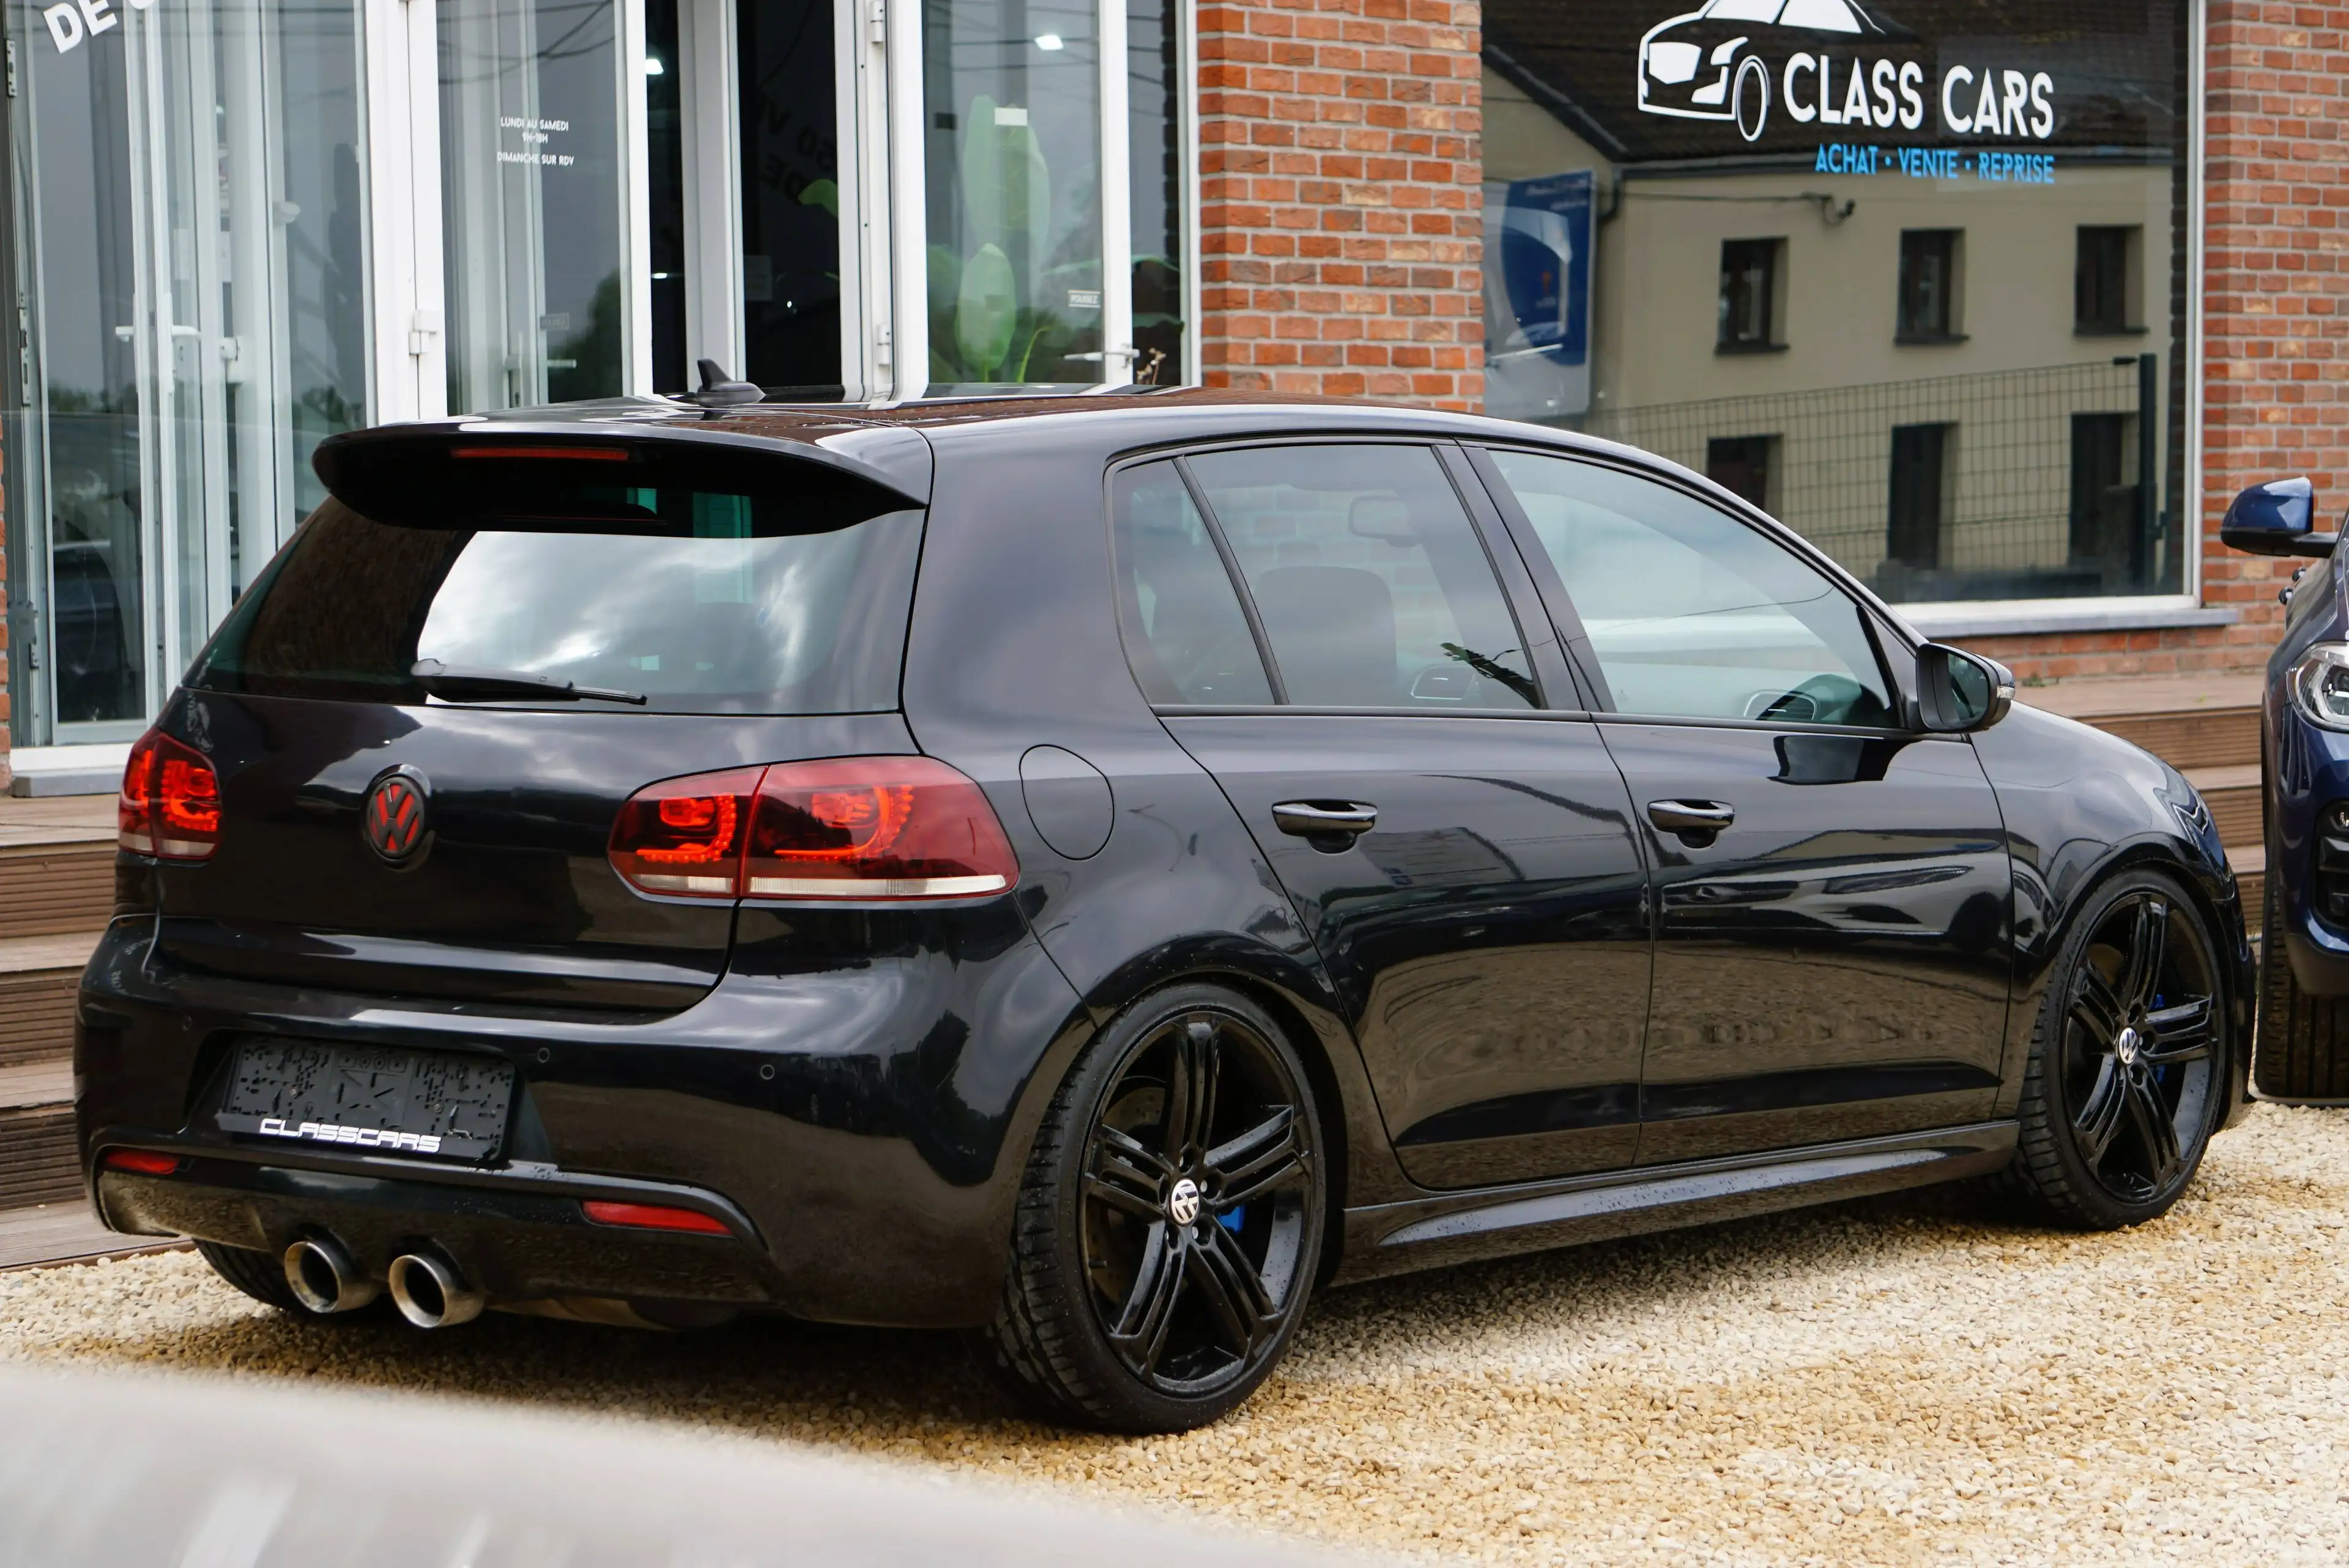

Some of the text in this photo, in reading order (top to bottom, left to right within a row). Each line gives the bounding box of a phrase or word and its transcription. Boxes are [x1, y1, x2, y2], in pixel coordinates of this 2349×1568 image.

[1783, 52, 2054, 139] CLASS CARS
[500, 116, 569, 131] LUNDI AU SAMEDI
[497, 151, 574, 166] DIMANCHE SUR RDV
[1815, 143, 2055, 183] ACHAT VENTE REPRISE
[259, 1117, 442, 1153] CLASSCARS
